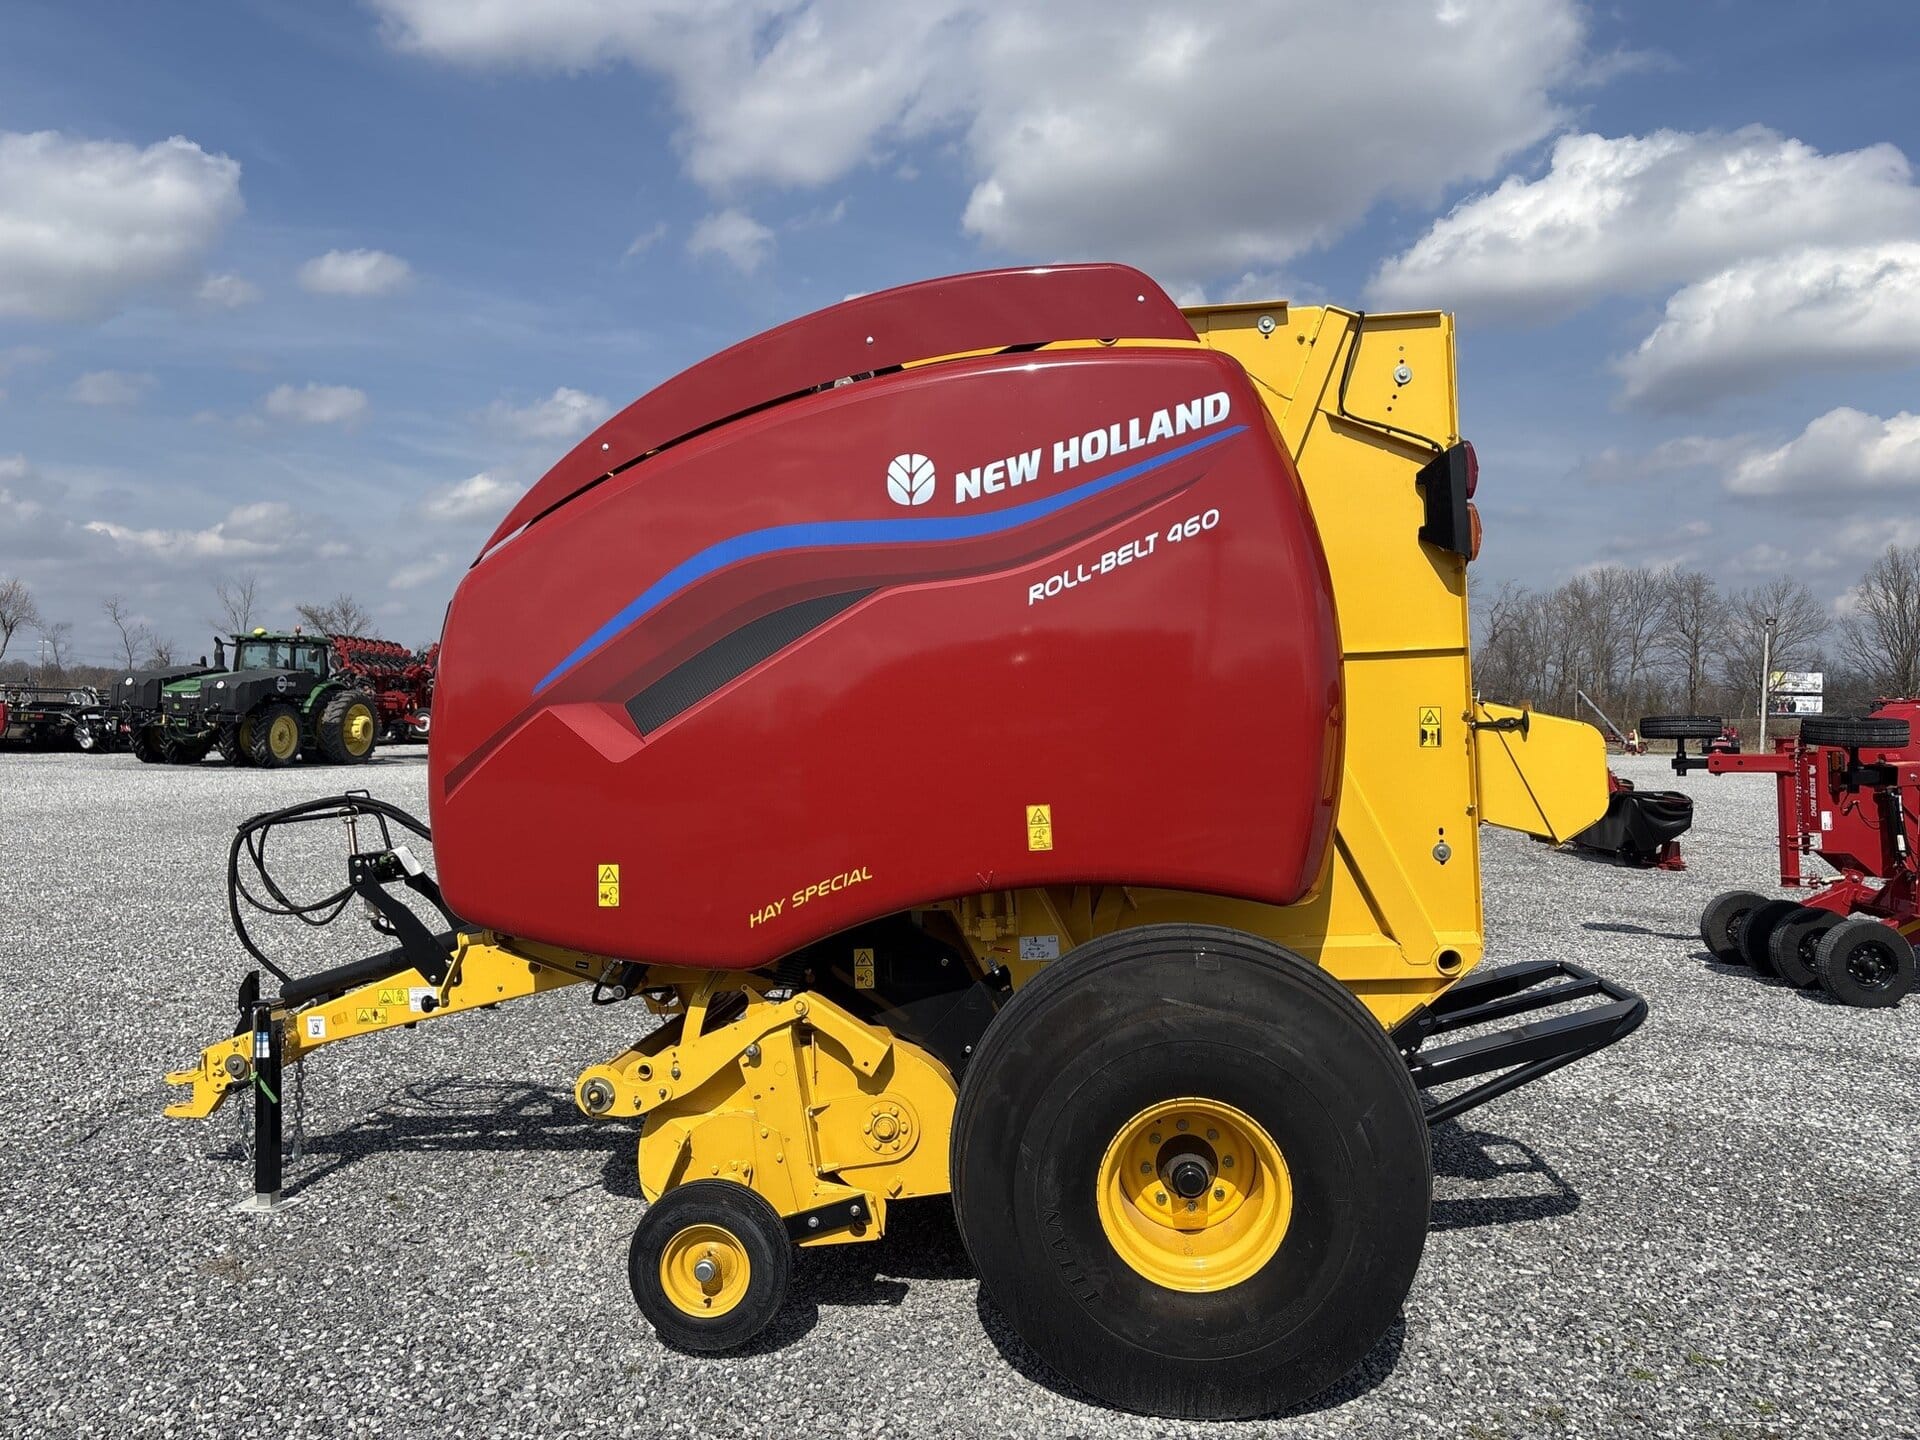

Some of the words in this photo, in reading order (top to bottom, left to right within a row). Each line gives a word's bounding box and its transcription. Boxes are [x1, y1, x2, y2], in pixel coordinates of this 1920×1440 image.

[955, 448, 1042, 504] NEW
[1052, 391, 1231, 473] HOLLAND
[1028, 532, 1159, 606] ROLL-BELT
[1166, 509, 1220, 543] 460
[749, 898, 786, 929] HAY
[791, 866, 873, 908] SPECIAL
[1043, 1209, 1101, 1309] TITAN
